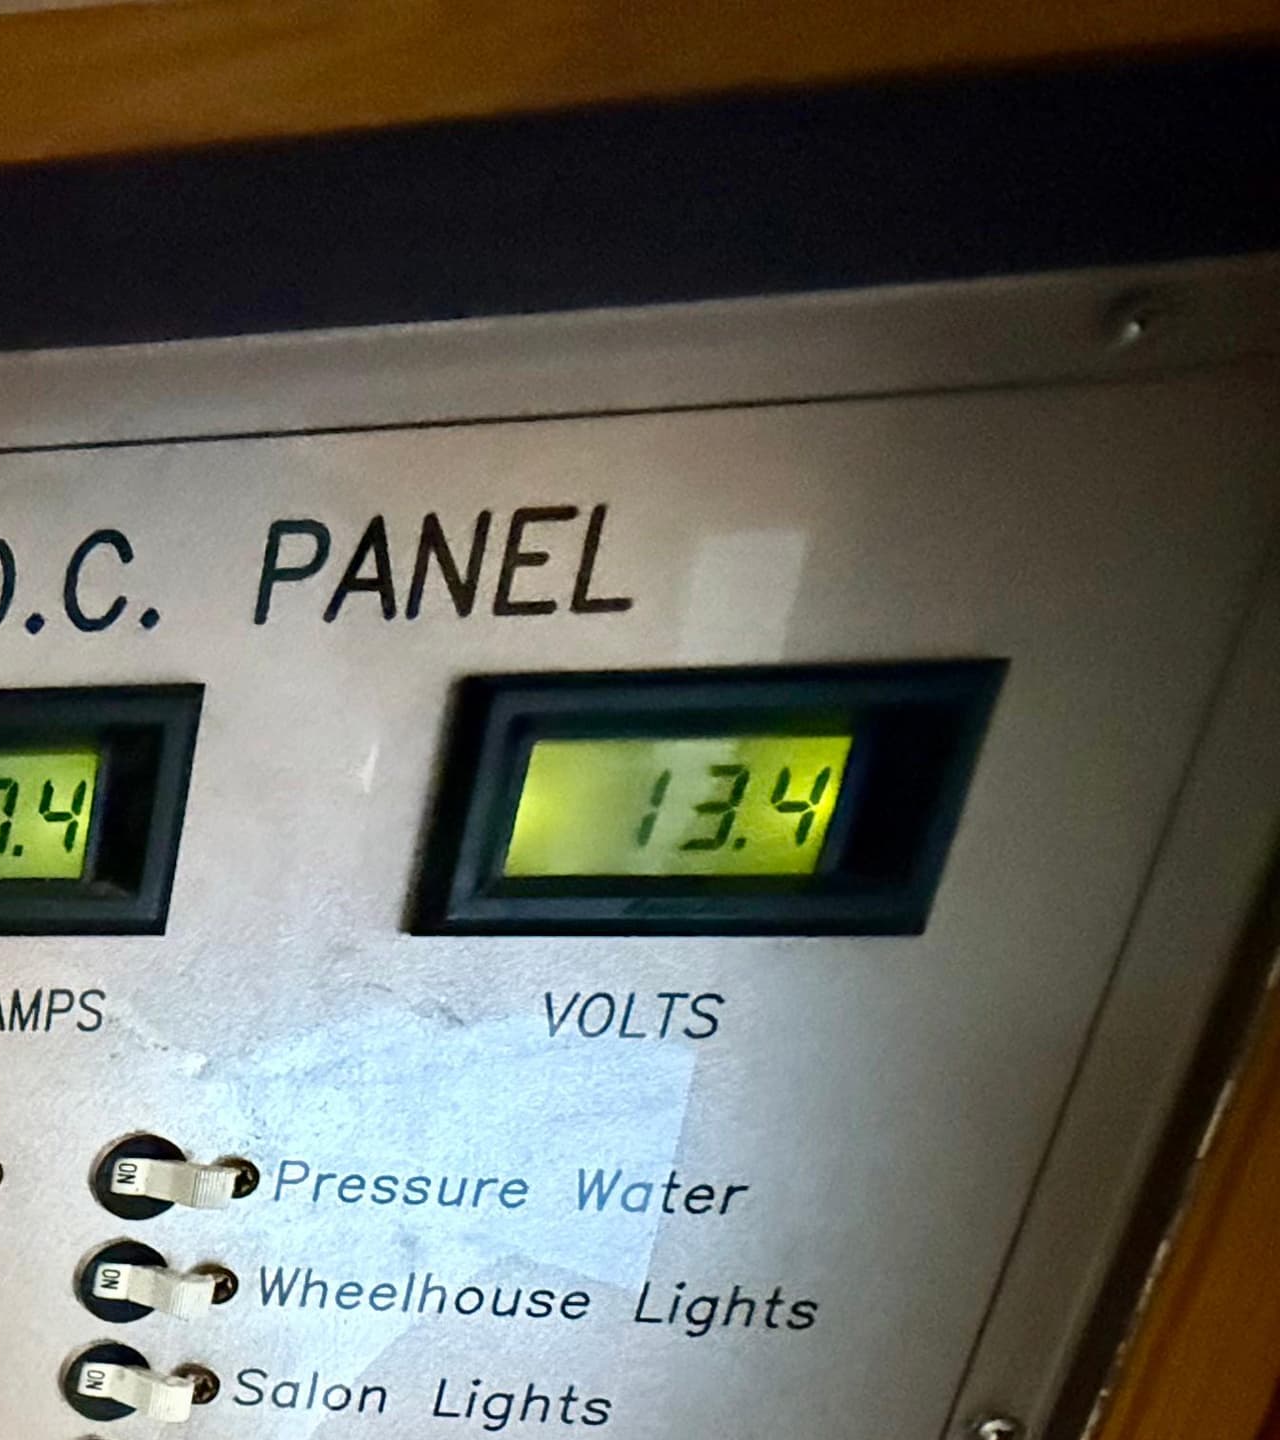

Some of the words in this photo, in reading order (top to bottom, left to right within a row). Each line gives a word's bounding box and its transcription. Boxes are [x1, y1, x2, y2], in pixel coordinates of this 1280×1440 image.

[254, 504, 633, 625] PANEL
[638, 764, 831, 851] 13.4
[545, 992, 725, 1039] VOLTS
[114, 1160, 140, 1187] ON
[272, 1160, 529, 1208] Pressure
[579, 1169, 749, 1215] Water
[99, 1268, 122, 1291] ON
[260, 1266, 590, 1320] Wheelhouse
[634, 1281, 818, 1338] Lights
[84, 1368, 107, 1392] ON
[232, 1368, 387, 1414] Salon
[433, 1378, 611, 1431] Lights
